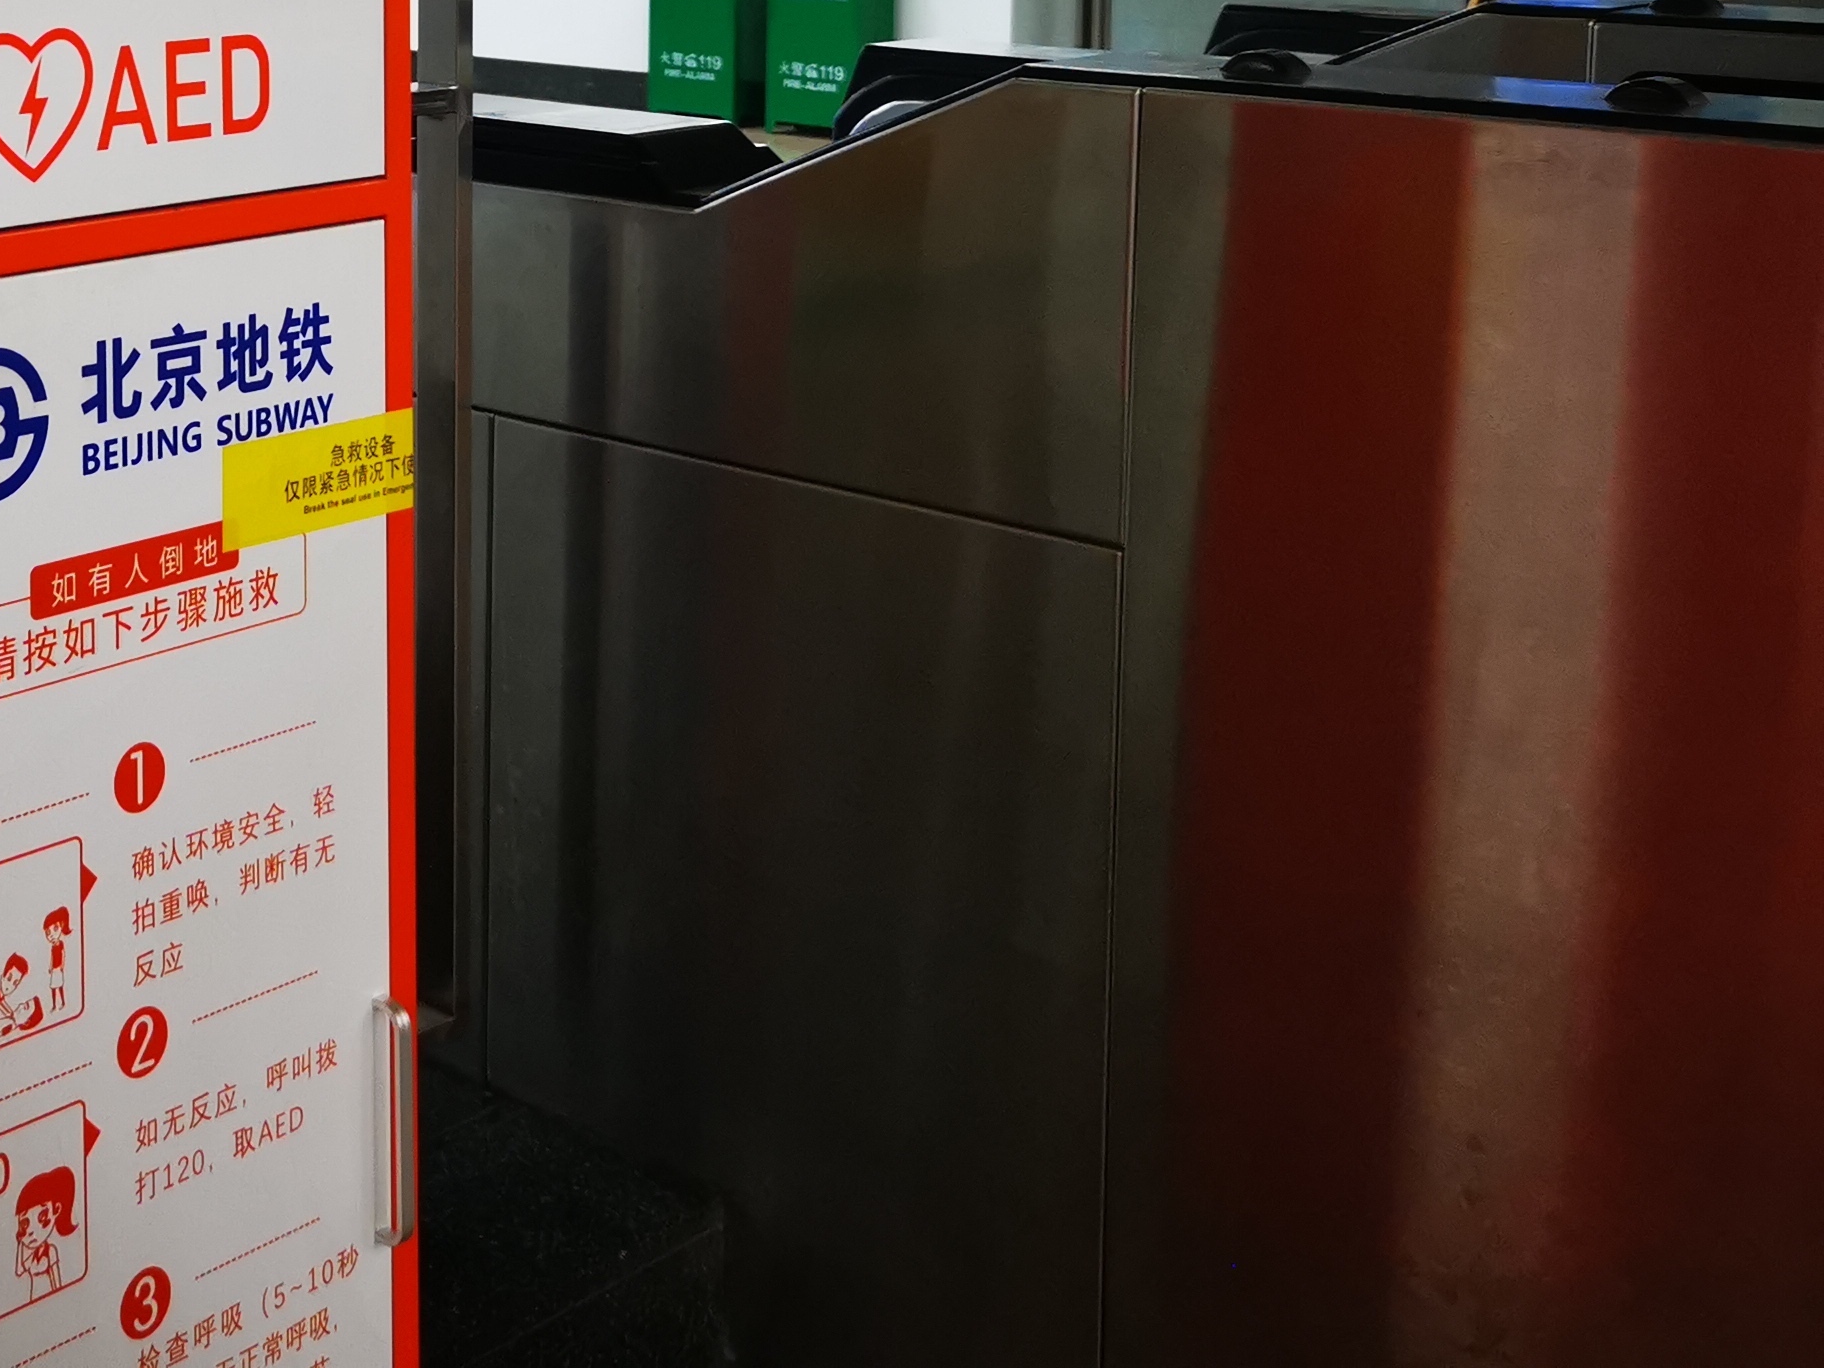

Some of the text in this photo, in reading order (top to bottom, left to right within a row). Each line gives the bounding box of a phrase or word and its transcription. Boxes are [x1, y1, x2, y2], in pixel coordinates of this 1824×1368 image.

[97, 34, 270, 152] AED
[80, 302, 334, 424] 北京地铁
[81, 393, 334, 476] BEIJING SUBWAY
[330, 434, 395, 468] 急救设备
[50, 535, 218, 608] 如有人倒地
[132, 941, 185, 988] 反应
[129, 1013, 156, 1074] 2
[133, 1274, 159, 1332] 3
